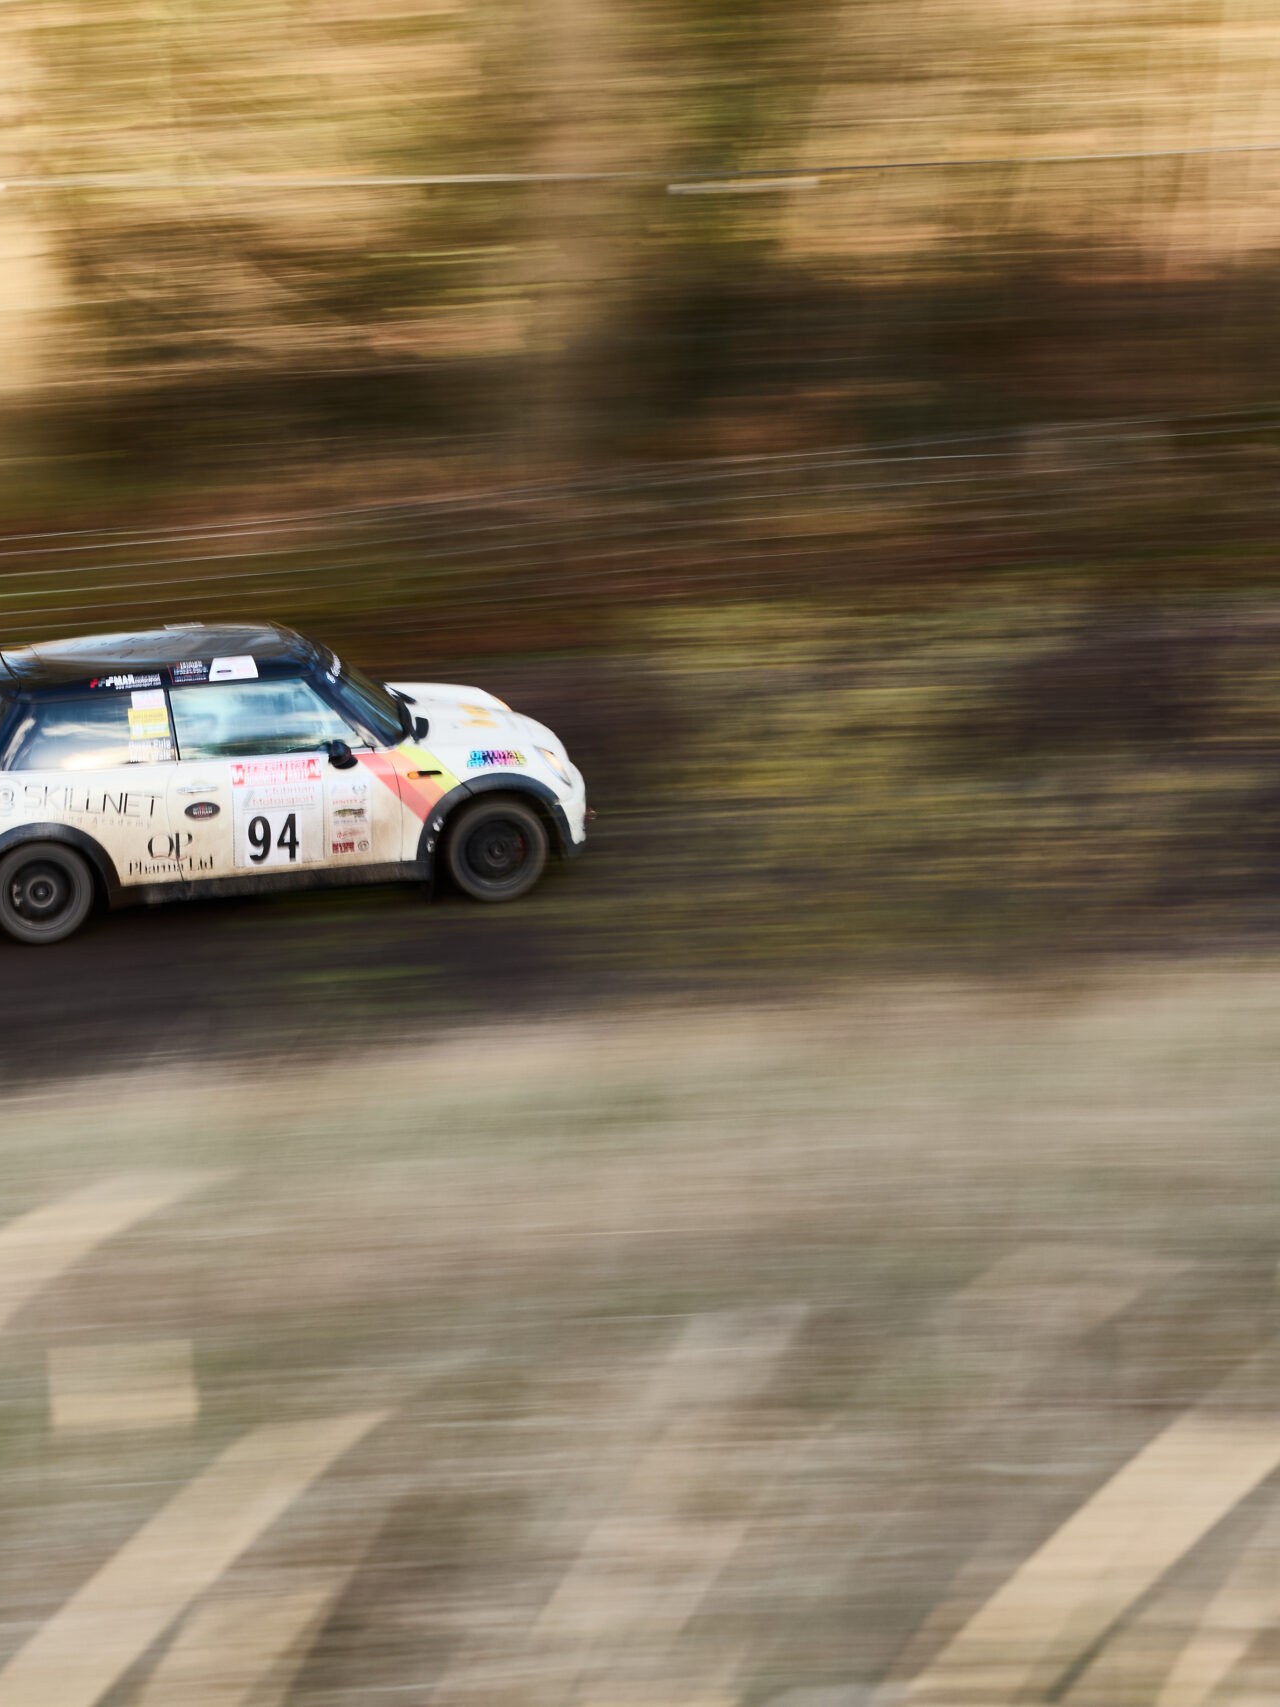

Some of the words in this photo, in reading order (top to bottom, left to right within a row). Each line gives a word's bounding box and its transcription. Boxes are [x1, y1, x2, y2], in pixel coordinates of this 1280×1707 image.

[25, 784, 163, 817] SKILLNET
[147, 832, 193, 860] QP
[248, 813, 300, 865] 94
[129, 861, 184, 876] Pharma
[189, 855, 214, 873] Ltd
